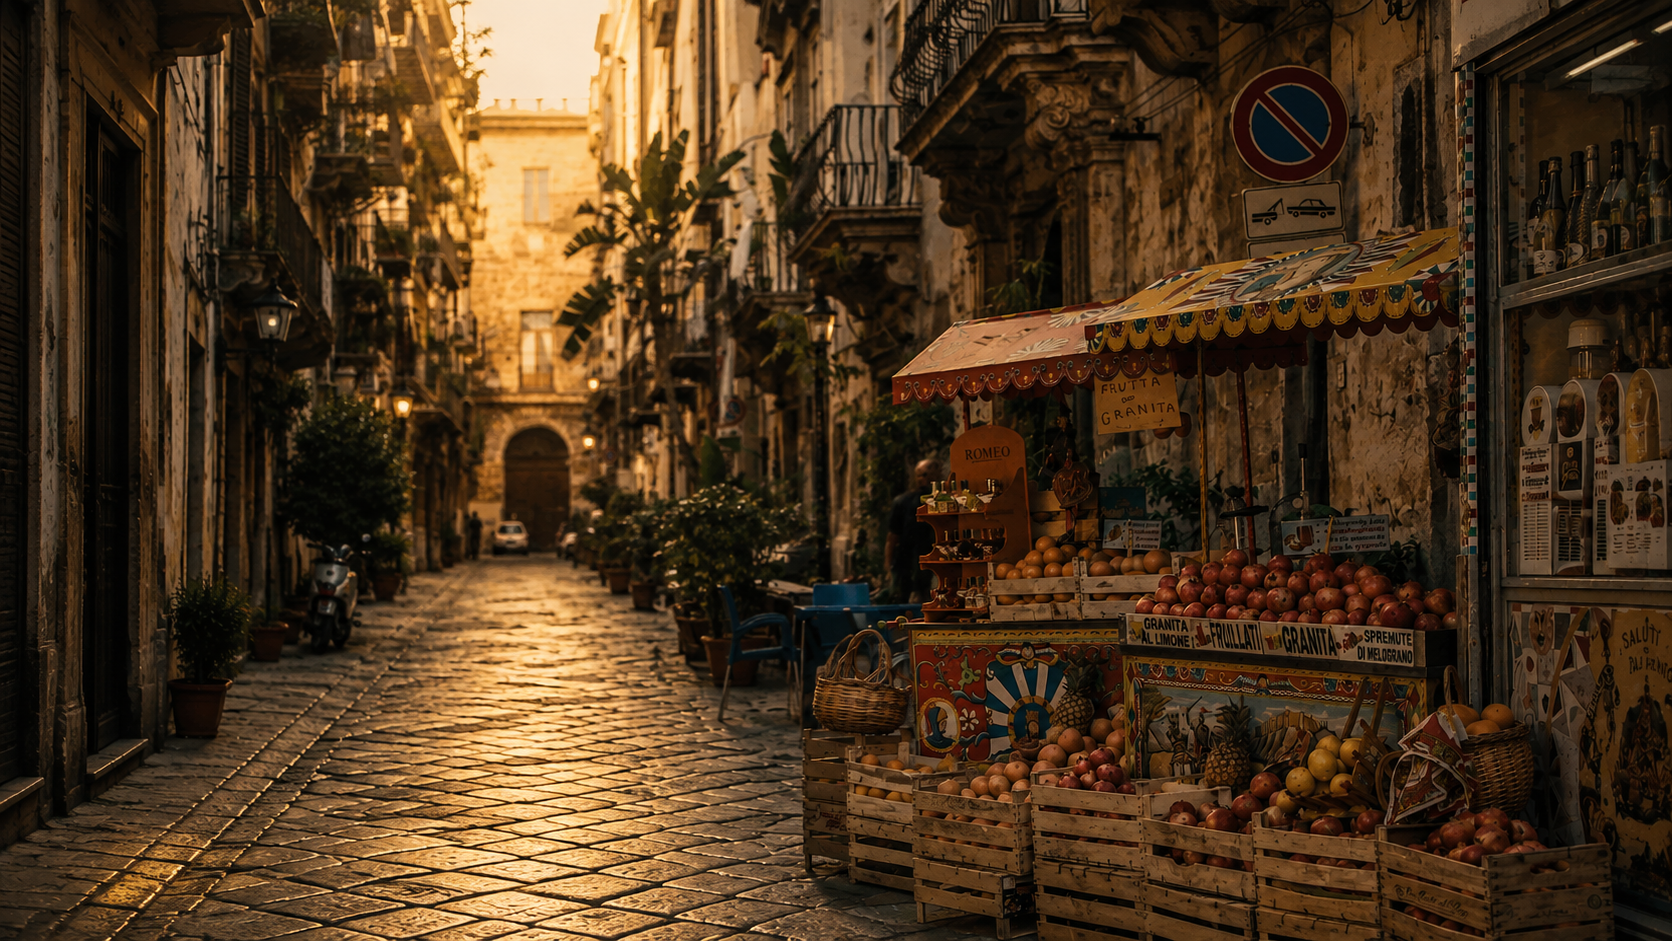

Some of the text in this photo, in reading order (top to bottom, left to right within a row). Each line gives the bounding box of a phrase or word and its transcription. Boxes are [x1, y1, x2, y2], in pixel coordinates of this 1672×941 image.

[1101, 377, 1160, 394] FRUTTA
[1101, 402, 1175, 425] GRANITA
[965, 446, 1011, 460] ROMEO
[1144, 617, 1189, 632] GRANITA
[1142, 628, 1190, 647] AL LIMONE
[1364, 629, 1412, 646] SPREMUTE
[1357, 646, 1366, 660] DI
